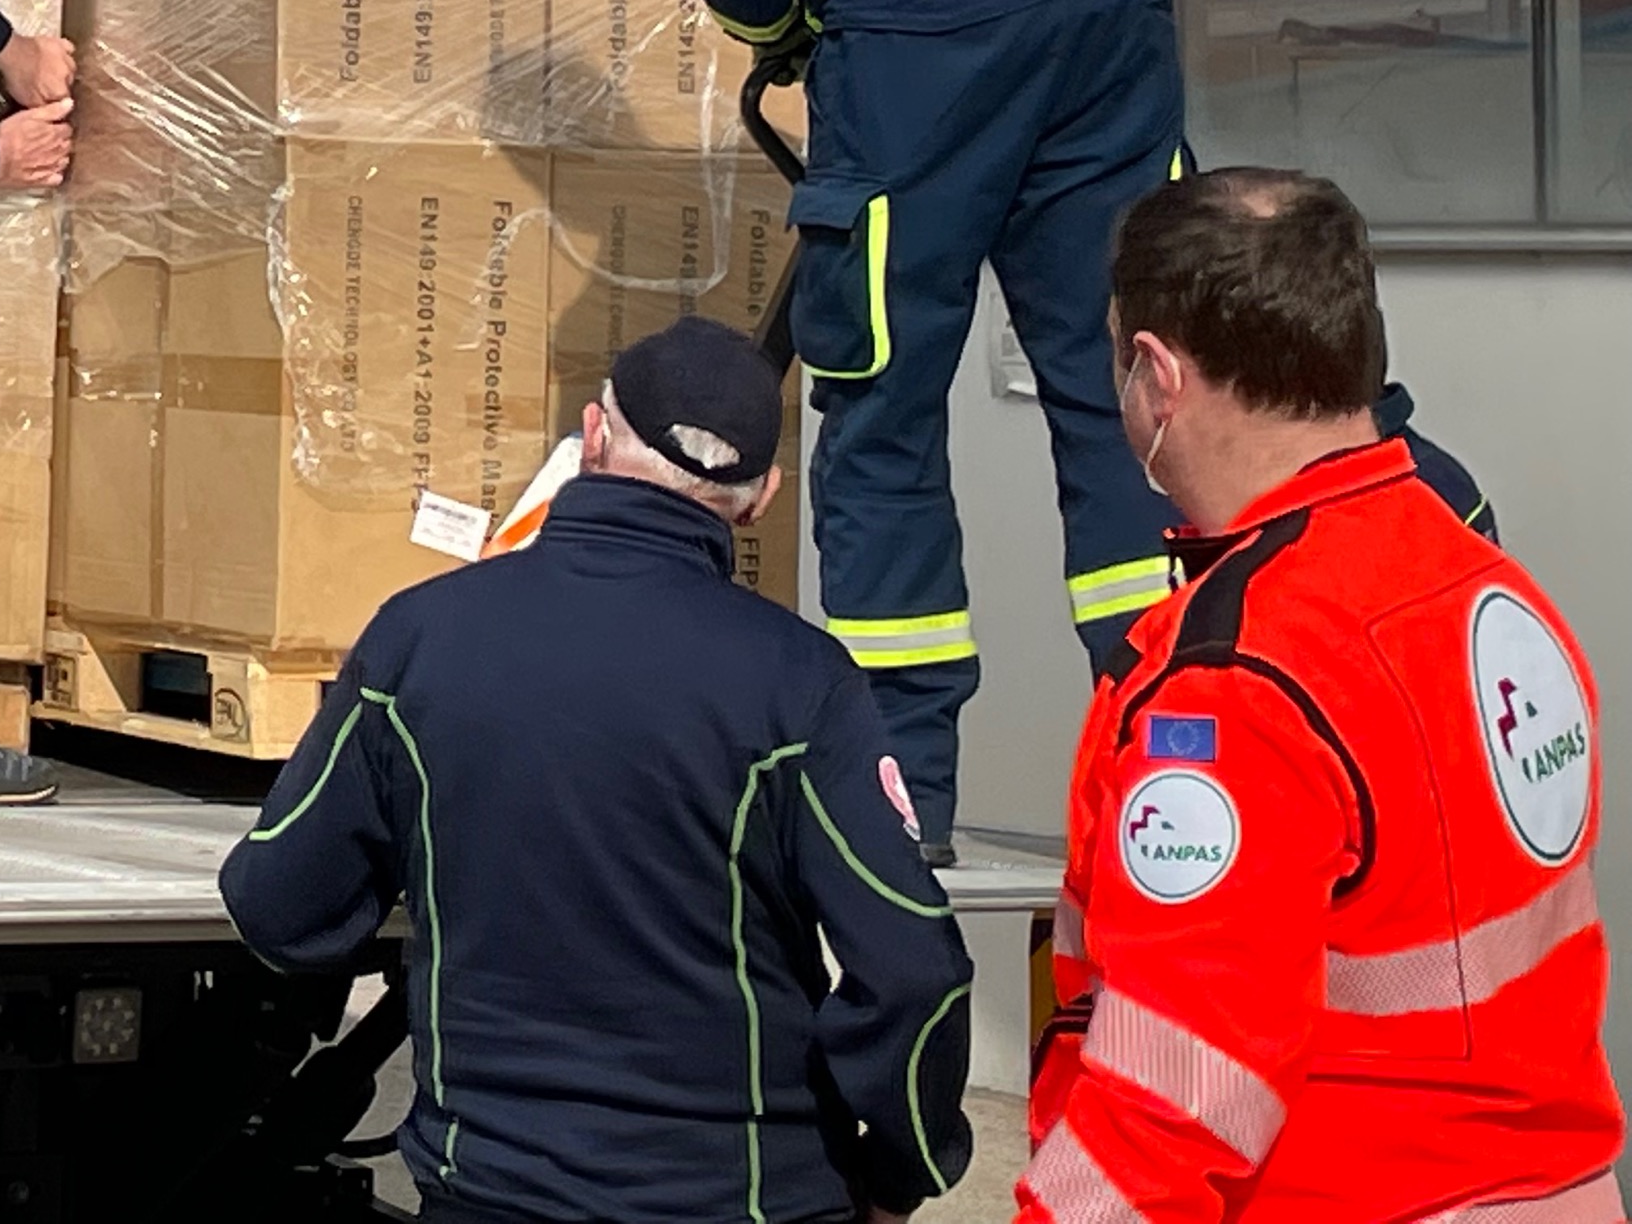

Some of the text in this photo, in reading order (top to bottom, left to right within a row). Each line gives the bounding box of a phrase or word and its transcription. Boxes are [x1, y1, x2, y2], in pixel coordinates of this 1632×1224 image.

[346, 195, 364, 271] CHENGDE
[747, 208, 771, 318] Foldable
[412, 196, 440, 445] EN149:2001+A1:2009
[482, 319, 509, 452] Protective
[739, 537, 760, 587] FFP
[1534, 721, 1586, 784] ANPAS
[1152, 843, 1223, 863] ANPAS
